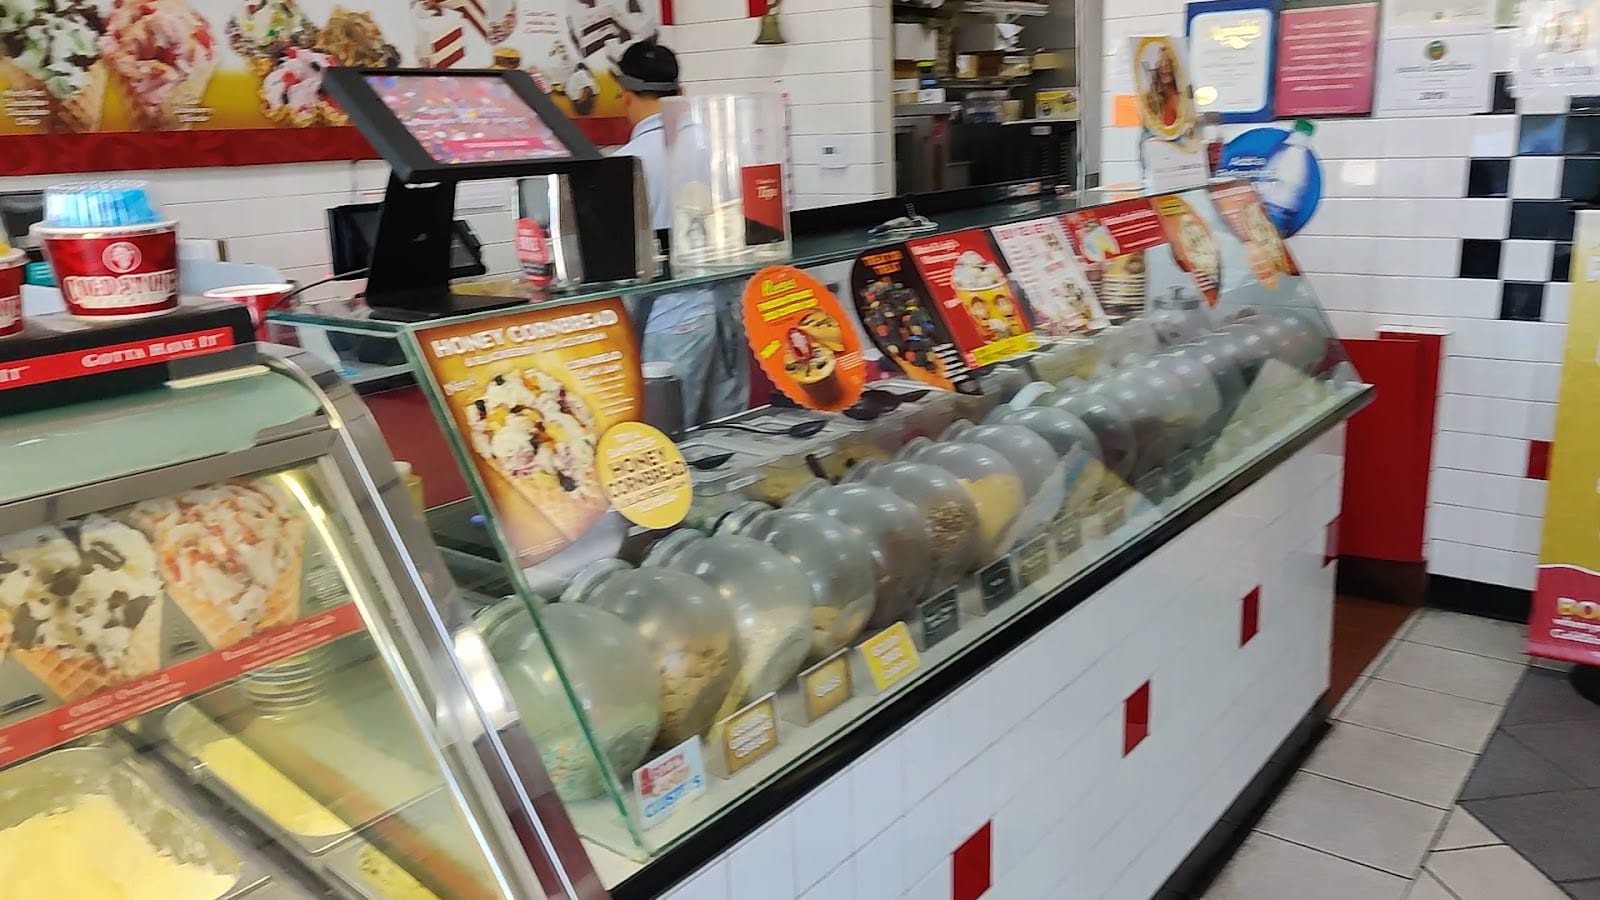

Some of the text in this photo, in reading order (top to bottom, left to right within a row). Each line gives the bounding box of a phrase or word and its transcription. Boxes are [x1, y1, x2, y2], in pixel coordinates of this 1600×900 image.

[430, 328, 506, 358] HONEY
[505, 309, 619, 344] CORNBREAD
[604, 460, 686, 498] CORNBREAD
[607, 446, 666, 480] HONEY
[1556, 597, 1600, 620] BO
